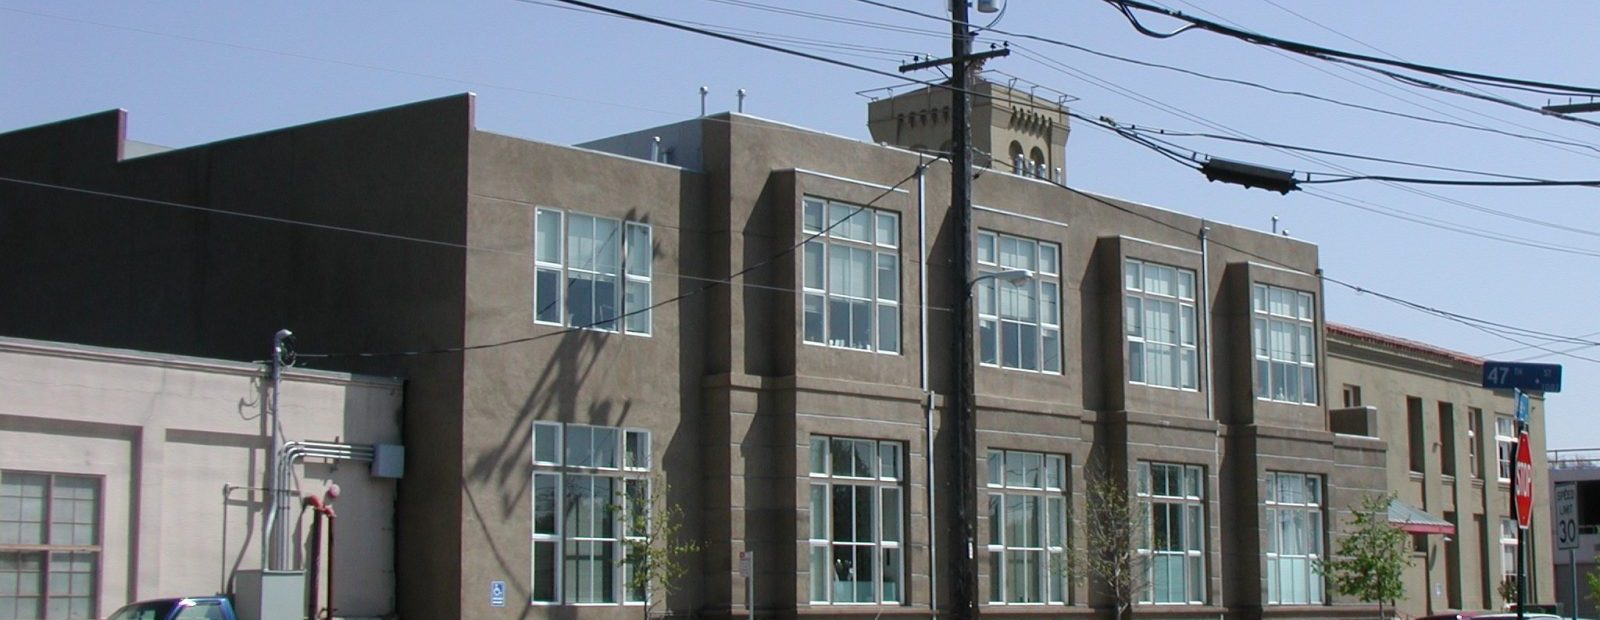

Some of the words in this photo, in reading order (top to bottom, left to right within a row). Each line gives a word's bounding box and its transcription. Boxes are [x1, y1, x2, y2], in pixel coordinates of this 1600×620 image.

[1487, 367, 1509, 384] 47
[1515, 462, 1531, 497] STOP
[1557, 489, 1574, 501] SPEED
[1559, 503, 1573, 516] LIMIT
[1559, 519, 1576, 543] 30
